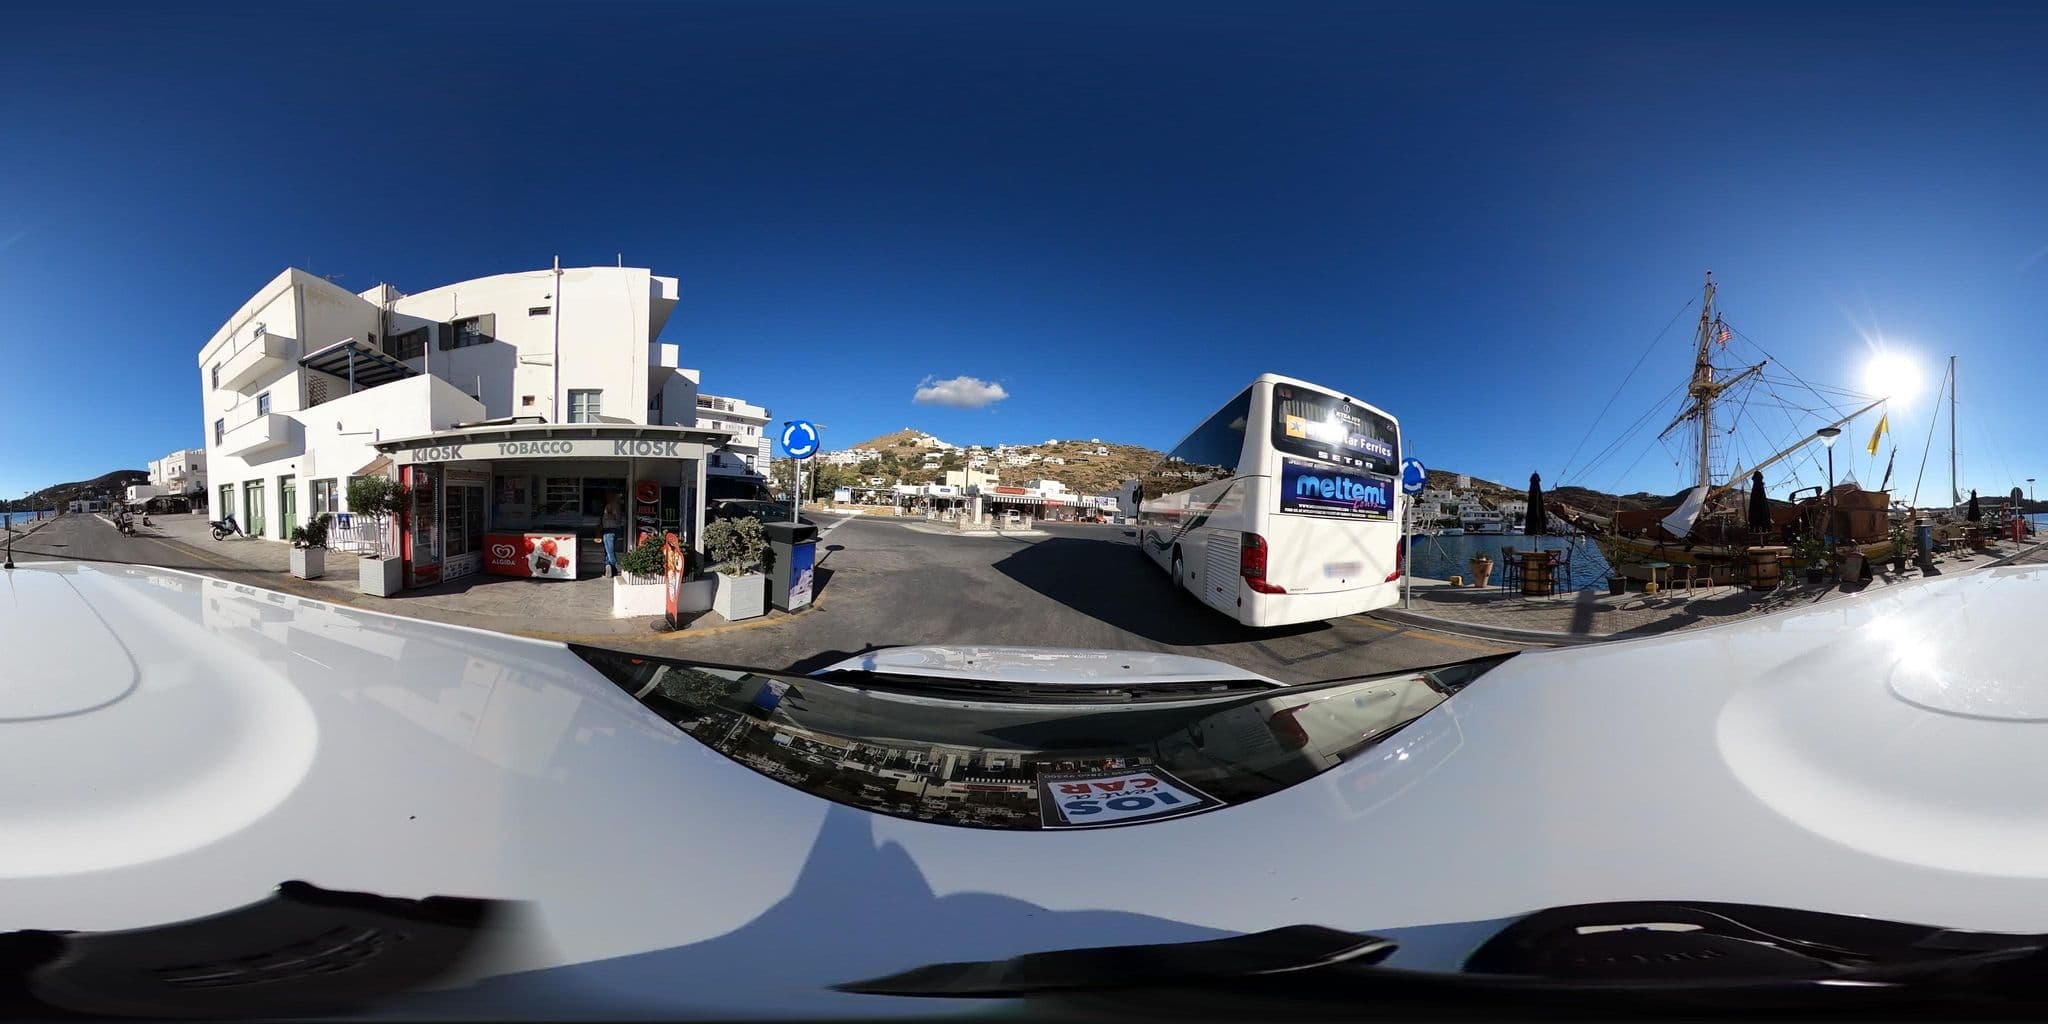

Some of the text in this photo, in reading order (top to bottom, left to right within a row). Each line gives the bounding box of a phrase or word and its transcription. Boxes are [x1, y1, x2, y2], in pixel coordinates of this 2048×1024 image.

[412, 445, 463, 462] KIOSK
[498, 440, 573, 456] TOBACCO
[614, 440, 679, 457] KIOSK
[1360, 438, 1392, 457] Ferries
[1296, 475, 1386, 505] meltemi
[492, 558, 516, 566] ALGIDA
[1058, 778, 1158, 794] CAR
[1067, 787, 1158, 801] rent a
[1064, 792, 1181, 815] IOS
